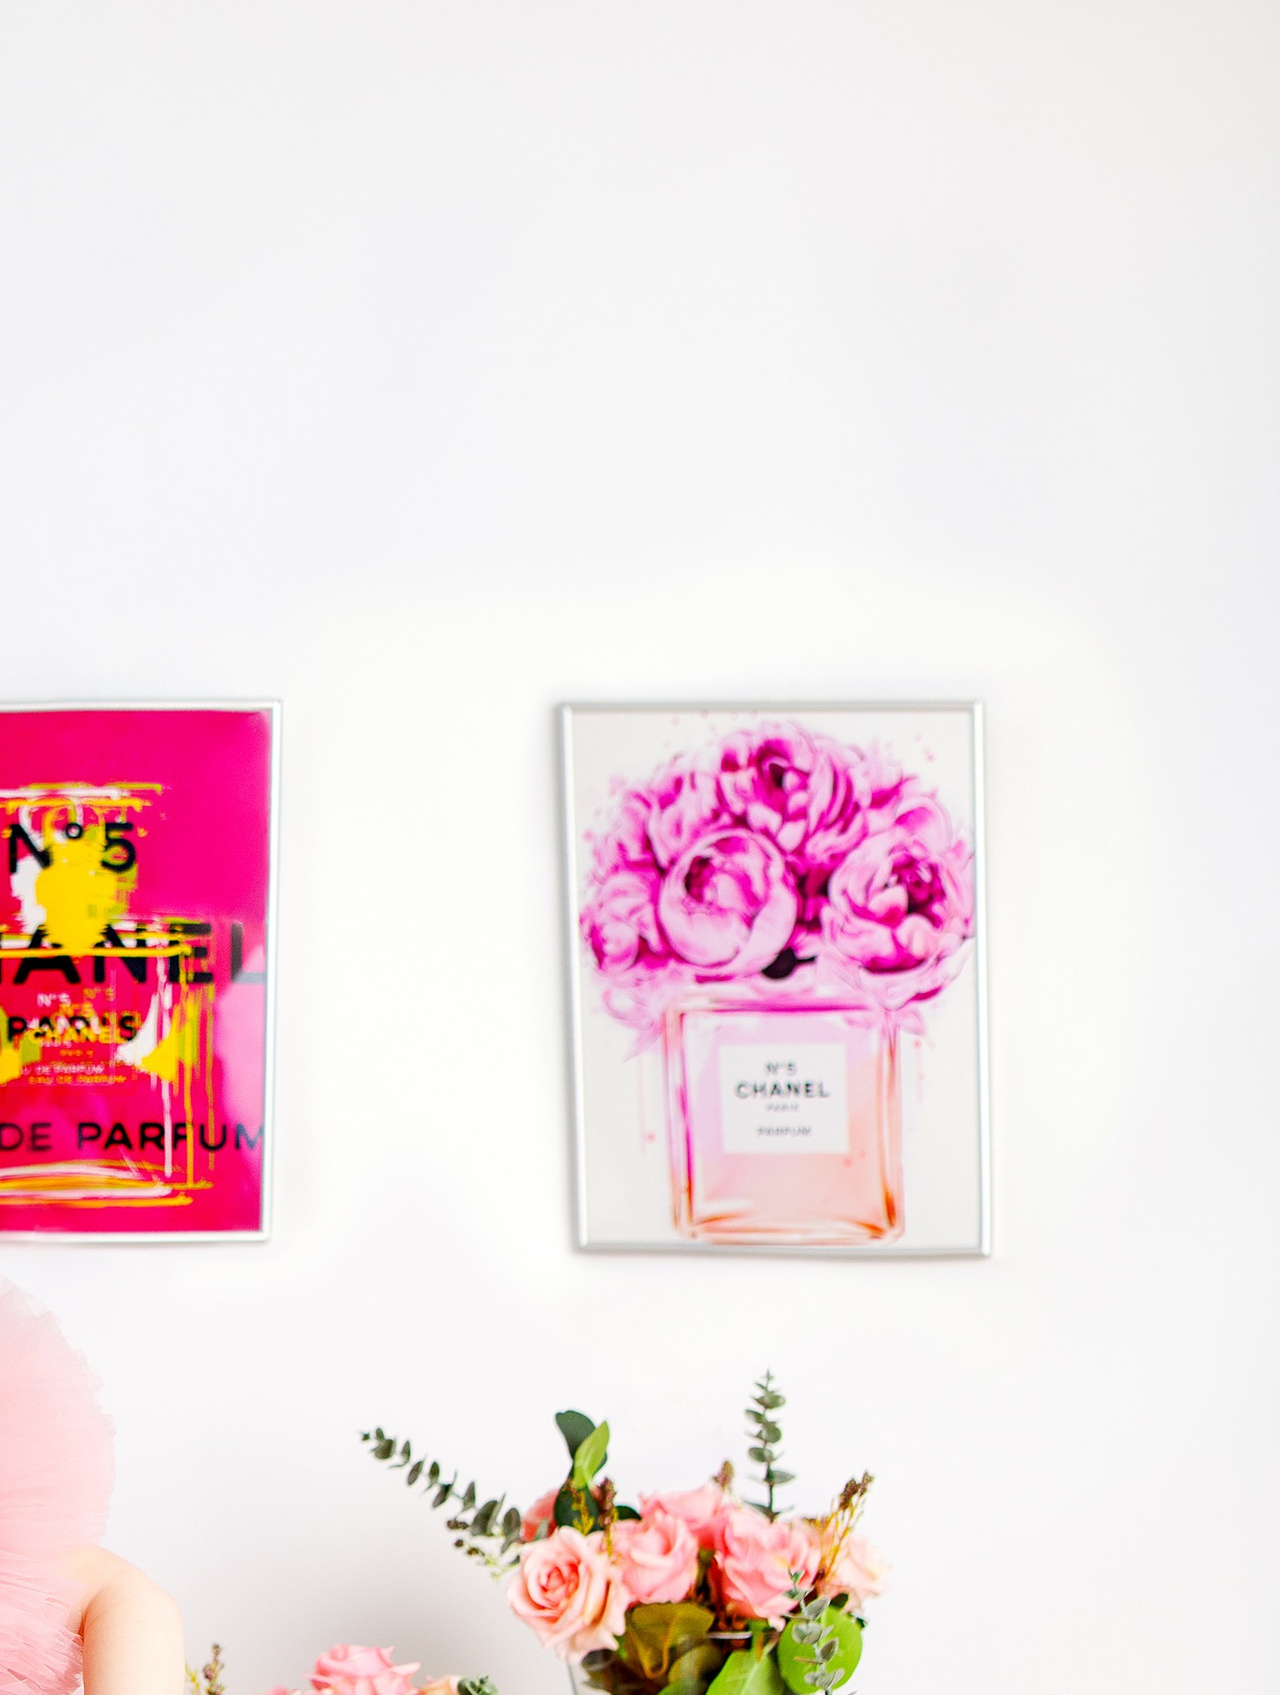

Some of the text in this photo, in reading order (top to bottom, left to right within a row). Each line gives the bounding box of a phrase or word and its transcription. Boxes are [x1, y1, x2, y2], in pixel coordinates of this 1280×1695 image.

[8, 822, 136, 873] N°5
[735, 1081, 831, 1098] CHANEL
[78, 1122, 264, 1150] PARFUM
